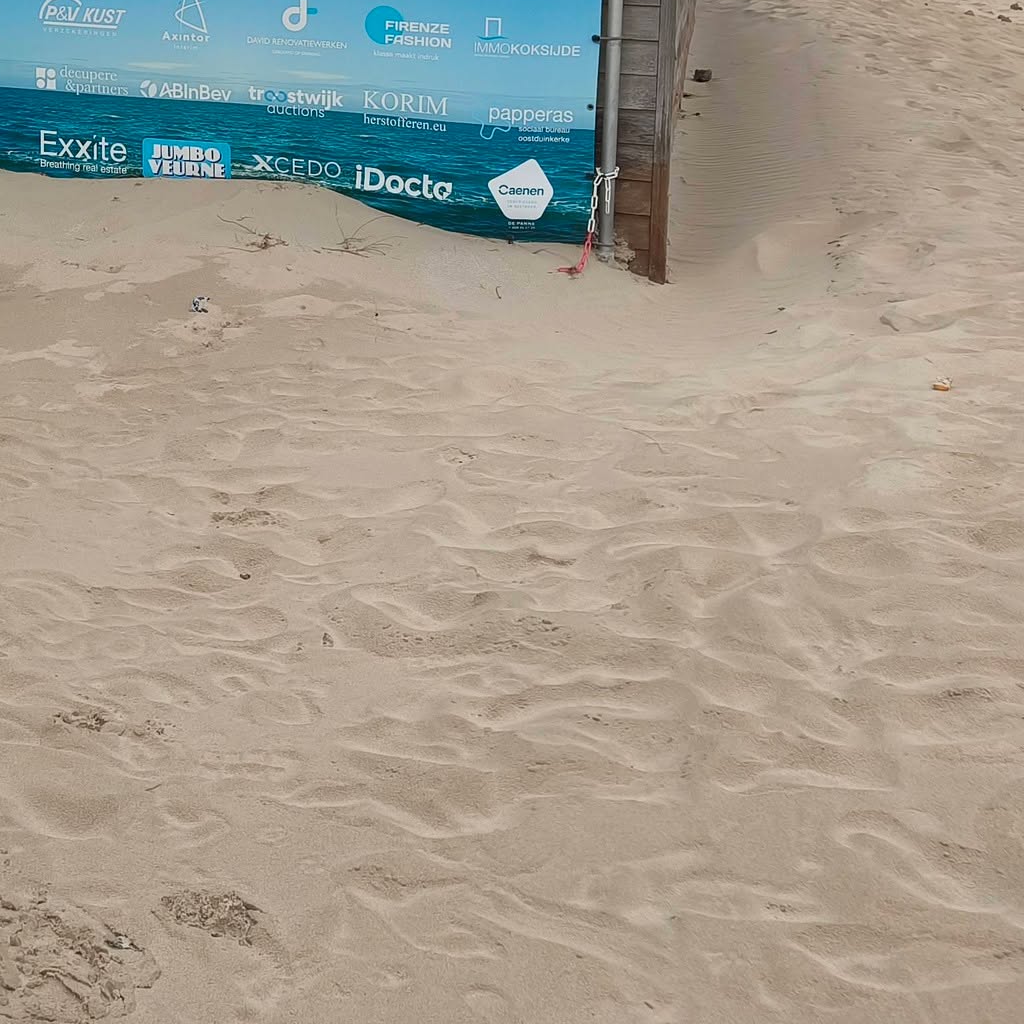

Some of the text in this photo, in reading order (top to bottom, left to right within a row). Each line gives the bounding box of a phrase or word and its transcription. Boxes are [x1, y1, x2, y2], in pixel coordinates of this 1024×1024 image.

[44, 5, 127, 25] P&V KUST
[162, 31, 211, 42] Axintor
[384, 20, 450, 34] FIRENZE
[246, 36, 348, 49] DAVID RENOVATIEWERKEN
[384, 34, 452, 49] FASHION
[59, 64, 118, 83] decupere
[65, 79, 129, 96] &partners
[158, 82, 232, 102] ABInBev
[248, 85, 344, 110] troostwijk
[363, 90, 449, 116] KORIM
[266, 104, 325, 118] auctions
[488, 106, 574, 126] papperas
[363, 112, 447, 132] herstofferen.eu
[545, 126, 570, 134] bureau
[40, 130, 128, 163] Exxite
[151, 144, 222, 163] JUMBO
[40, 159, 128, 174] Breathing real estate
[148, 159, 226, 178] VEURNE
[252, 154, 342, 178] XCEDO
[355, 164, 453, 201] iDocta
[498, 184, 544, 196] Caenen
